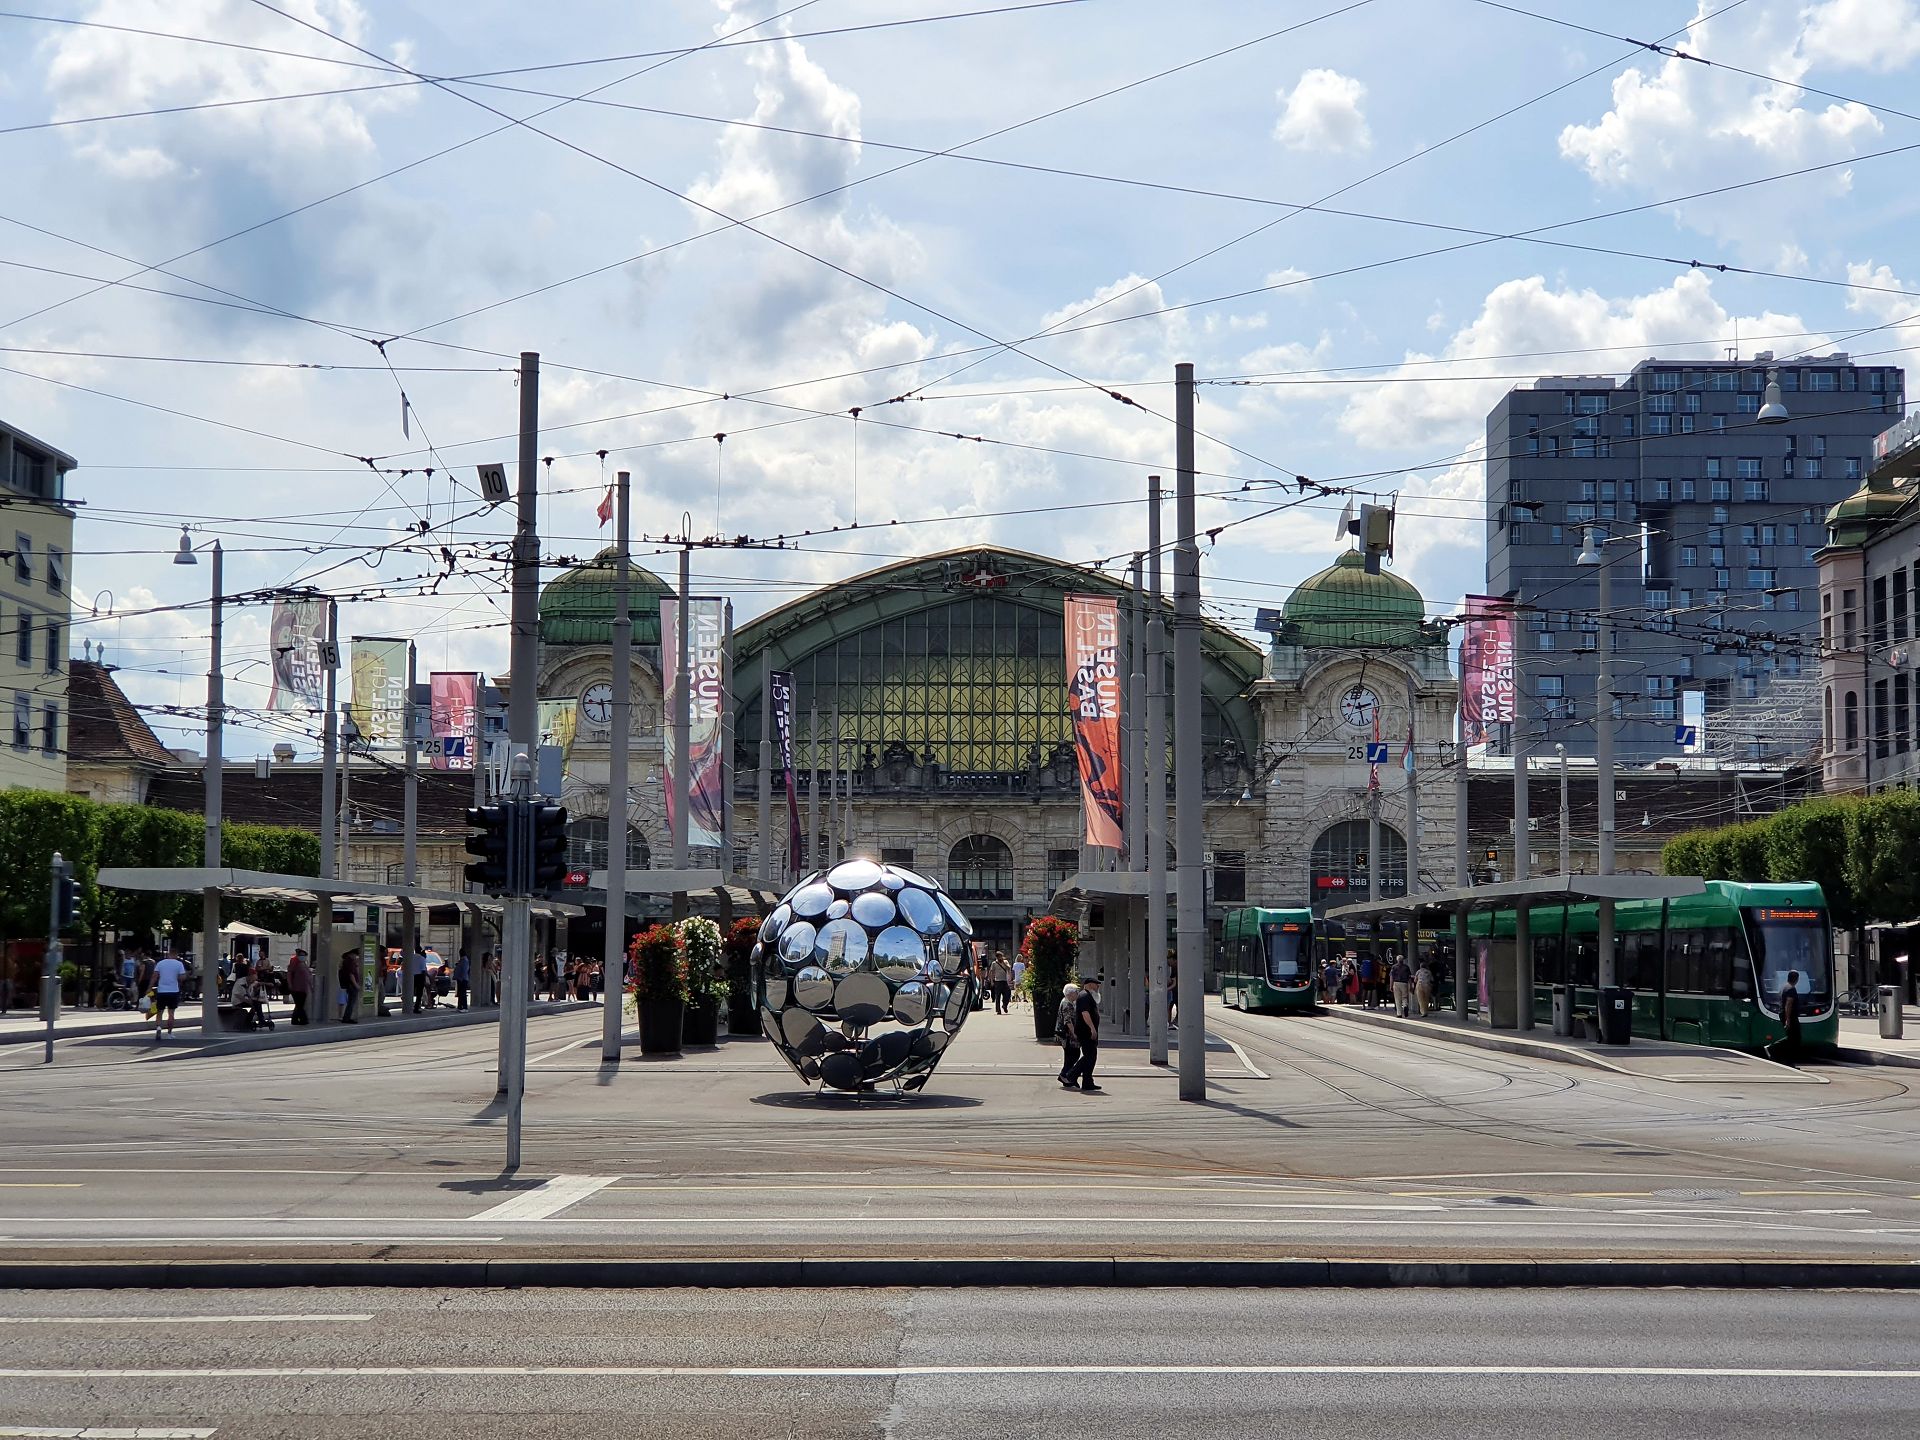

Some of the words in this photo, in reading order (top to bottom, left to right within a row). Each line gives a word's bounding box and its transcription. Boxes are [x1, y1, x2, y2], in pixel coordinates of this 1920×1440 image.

[484, 471, 503, 494] 10
[322, 646, 337, 666] 15
[425, 740, 441, 754] 25
[1348, 746, 1364, 760] 25
[1617, 791, 1625, 800] K
[1204, 853, 1212, 861] 15
[1348, 878, 1367, 886] SBB
[1388, 878, 1404, 886] FFS
